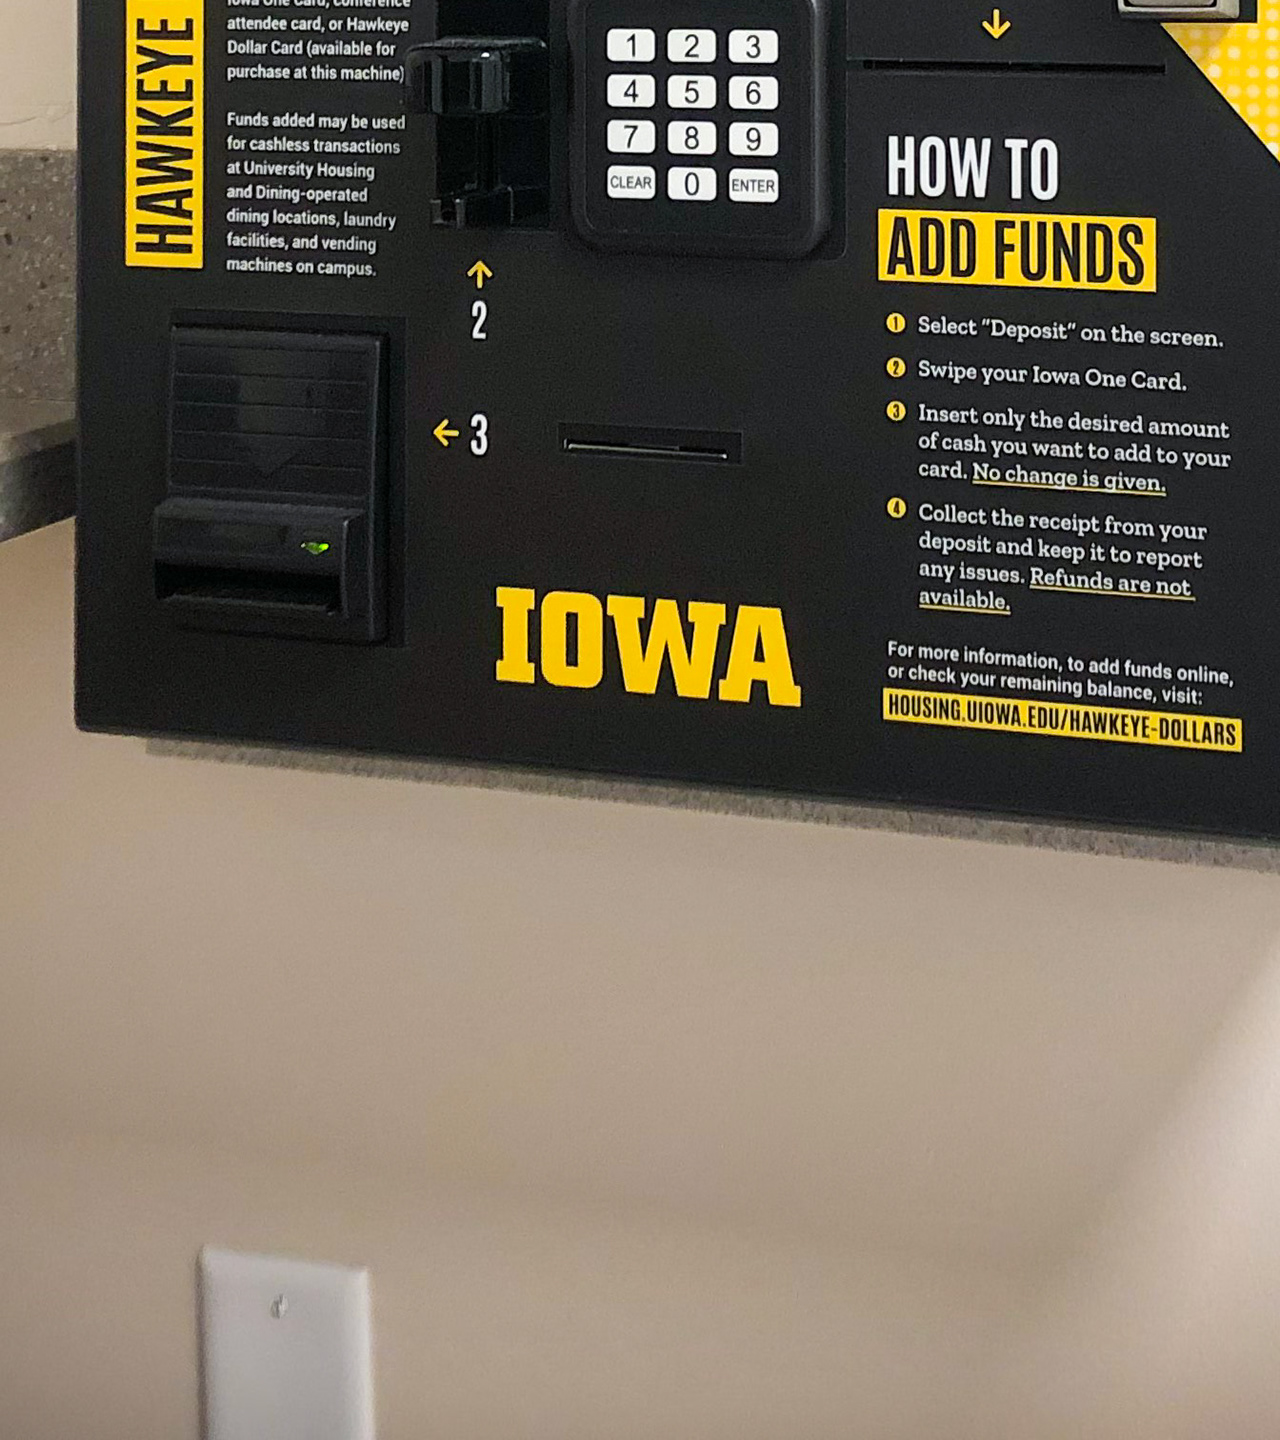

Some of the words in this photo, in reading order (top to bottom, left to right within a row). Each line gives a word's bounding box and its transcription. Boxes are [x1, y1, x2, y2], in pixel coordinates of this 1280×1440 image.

[227, 15, 287, 30] attendee
[291, 16, 325, 33] card,
[329, 20, 343, 31] or
[347, 17, 409, 35] Hawkeye
[227, 39, 268, 54] Dollar
[271, 40, 303, 54] Card
[306, 40, 372, 58] (available
[376, 41, 396, 56] for
[626, 34, 636, 57] 1
[684, 34, 700, 58] 2
[745, 34, 761, 59] 3
[227, 63, 290, 81] purchase
[294, 66, 307, 79] at
[311, 64, 337, 79] this
[341, 65, 404, 83] machine)
[623, 79, 639, 103] 4
[684, 80, 700, 105] 5
[745, 81, 761, 106] 6
[227, 112, 269, 126] Funds
[272, 112, 315, 127] added
[319, 117, 348, 132] may
[351, 114, 368, 129] be
[372, 115, 405, 129] used
[135, 17, 193, 255] HAWKEYE
[227, 135, 247, 150] for
[249, 136, 310, 152] cashless
[313, 139, 400, 154] transactions
[624, 125, 639, 148] 7
[684, 126, 700, 150] 8
[745, 127, 761, 151] 9
[227, 161, 240, 174] at
[244, 160, 314, 179] University
[317, 162, 374, 181] Housing
[888, 136, 991, 198] HOW
[1004, 138, 1058, 200] TO
[227, 184, 252, 198] and
[256, 185, 367, 204] Dining-operated
[610, 175, 652, 190] CLEAR
[684, 172, 700, 196] 0
[732, 178, 775, 194] ENTER
[226, 208, 269, 227] dining
[273, 209, 340, 227] locations,
[344, 211, 396, 231] laundry
[227, 231, 289, 250] facilities,
[292, 234, 318, 249] and
[322, 236, 376, 255] vending
[887, 217, 976, 277] ADD
[995, 220, 1144, 285] FUNDS
[227, 257, 293, 272] machines
[296, 262, 314, 273] on
[317, 263, 376, 278] campus.
[471, 300, 487, 340] 2
[919, 316, 977, 335] Select
[1081, 328, 1106, 341] on
[1111, 324, 1145, 343] the
[1150, 331, 1223, 347] screen.
[919, 360, 977, 384] Swipe
[981, 368, 1028, 385] your
[1033, 366, 1080, 385] Iowa
[1085, 369, 1126, 387] One
[1131, 371, 1187, 391] Card.
[919, 404, 978, 424] Insert
[983, 408, 1025, 431] only
[1030, 410, 1063, 429] the
[1068, 412, 1144, 433] desired
[1148, 422, 1230, 438] amount
[470, 413, 489, 456] 3
[919, 431, 939, 449] of
[942, 434, 987, 452] cash
[991, 440, 1027, 458] you
[1032, 442, 1083, 458] want
[1088, 443, 1109, 459] to
[1114, 443, 1152, 462] add
[1156, 447, 1178, 464] to
[1182, 452, 1231, 470] your
[919, 461, 968, 479] card.
[972, 462, 1000, 481] No
[1005, 464, 1077, 487] change
[1082, 468, 1100, 486] is
[1104, 471, 1166, 492] given.
[919, 503, 987, 525] Collect
[991, 508, 1024, 527] the
[1029, 514, 1100, 537] receipt
[1105, 515, 1155, 536] from
[1159, 524, 1207, 542] your
[919, 530, 991, 555] deposit
[996, 538, 1033, 556] and
[1038, 539, 1085, 564] keep
[1090, 543, 1105, 561] it
[1110, 546, 1131, 563] to
[1136, 551, 1202, 571] report
[919, 564, 955, 583] any
[959, 562, 1025, 583] issues.
[1030, 567, 1113, 590] Refunds
[1118, 579, 1151, 594] are
[1156, 580, 1191, 596] not
[919, 588, 1011, 610] available.
[496, 586, 802, 708] IOWA
[888, 640, 914, 657] For
[918, 646, 959, 661] more
[964, 646, 1062, 673] information,
[1067, 656, 1084, 672] to
[1089, 658, 1119, 675] add
[1124, 659, 1172, 679] funds
[1177, 666, 1233, 687] online,
[888, 666, 904, 678] or
[908, 664, 956, 684] check
[960, 672, 996, 688] your
[1001, 675, 1082, 698] remaining
[1087, 679, 1156, 703] balance,
[1162, 686, 1202, 705] visit:
[889, 694, 1236, 746] HOUSING.UIOWA.EDU/HAWKEYE-DOLLARS
